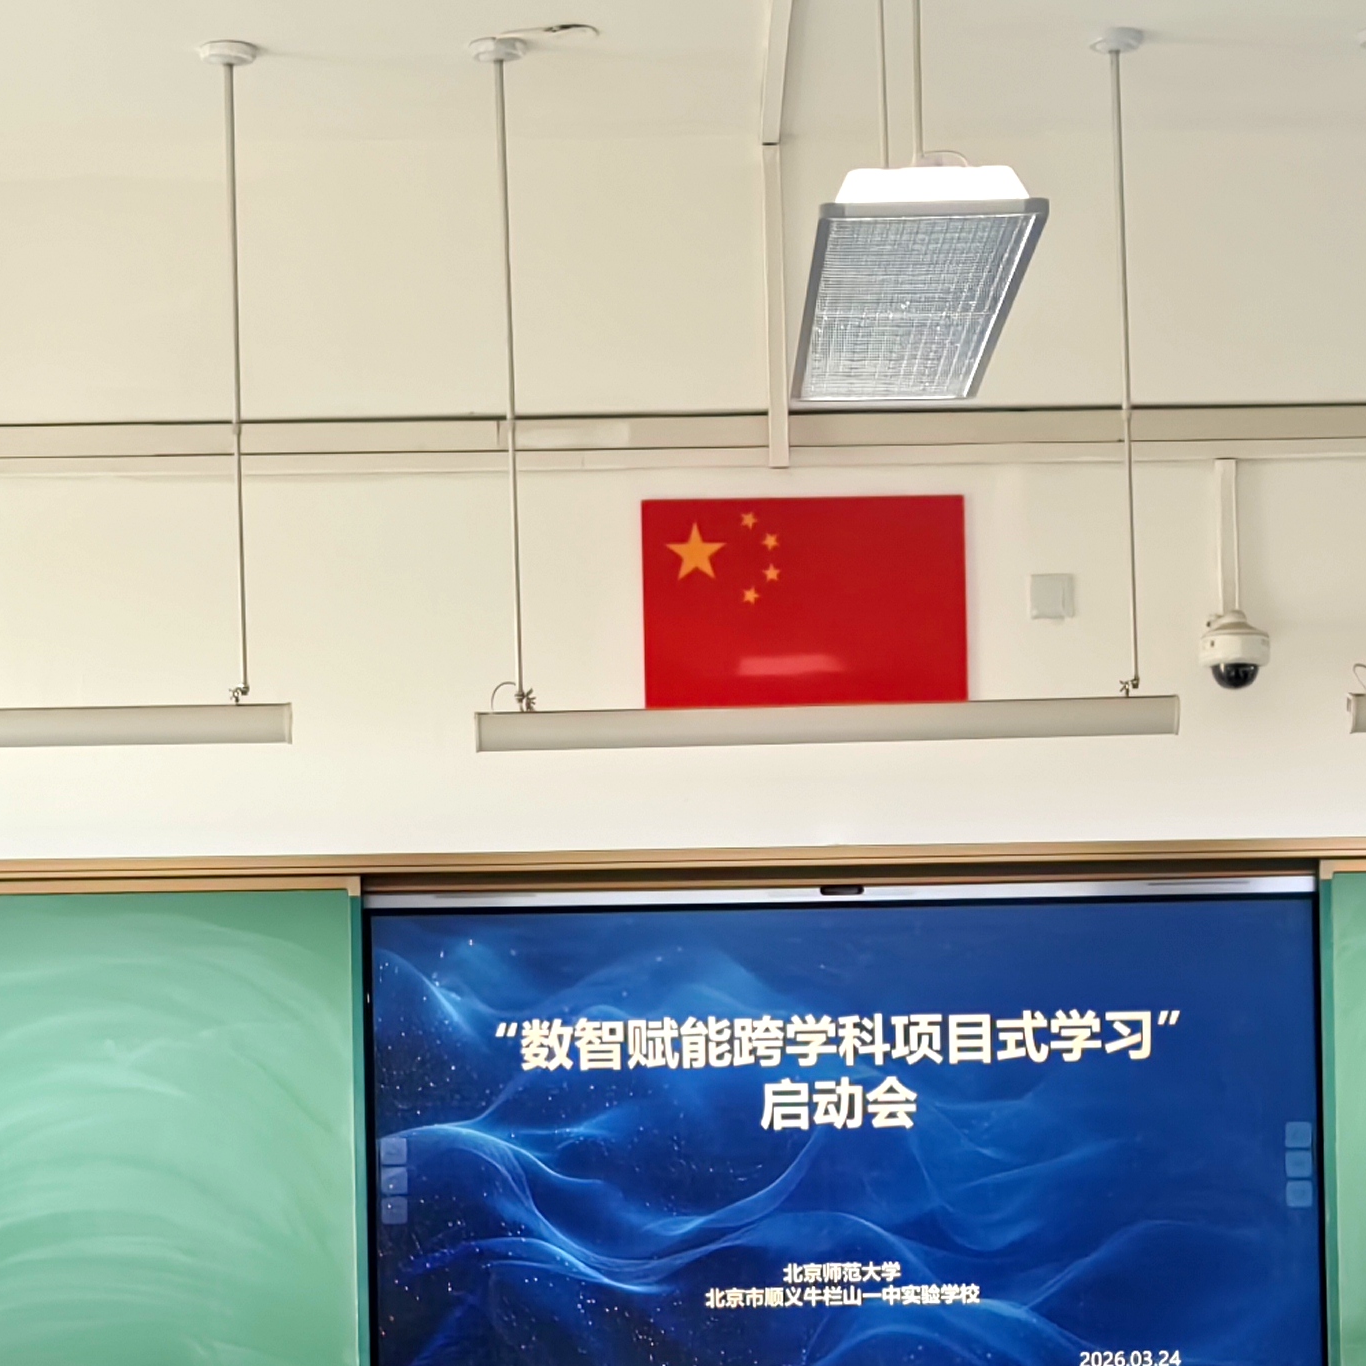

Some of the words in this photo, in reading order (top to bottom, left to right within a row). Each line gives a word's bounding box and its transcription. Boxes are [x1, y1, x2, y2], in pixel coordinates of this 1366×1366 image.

[760, 1076, 918, 1131] 启动会
[782, 1262, 902, 1284] 北京师范大学
[705, 1284, 981, 1309] 北京市顺义牛栏山一中实验学校
